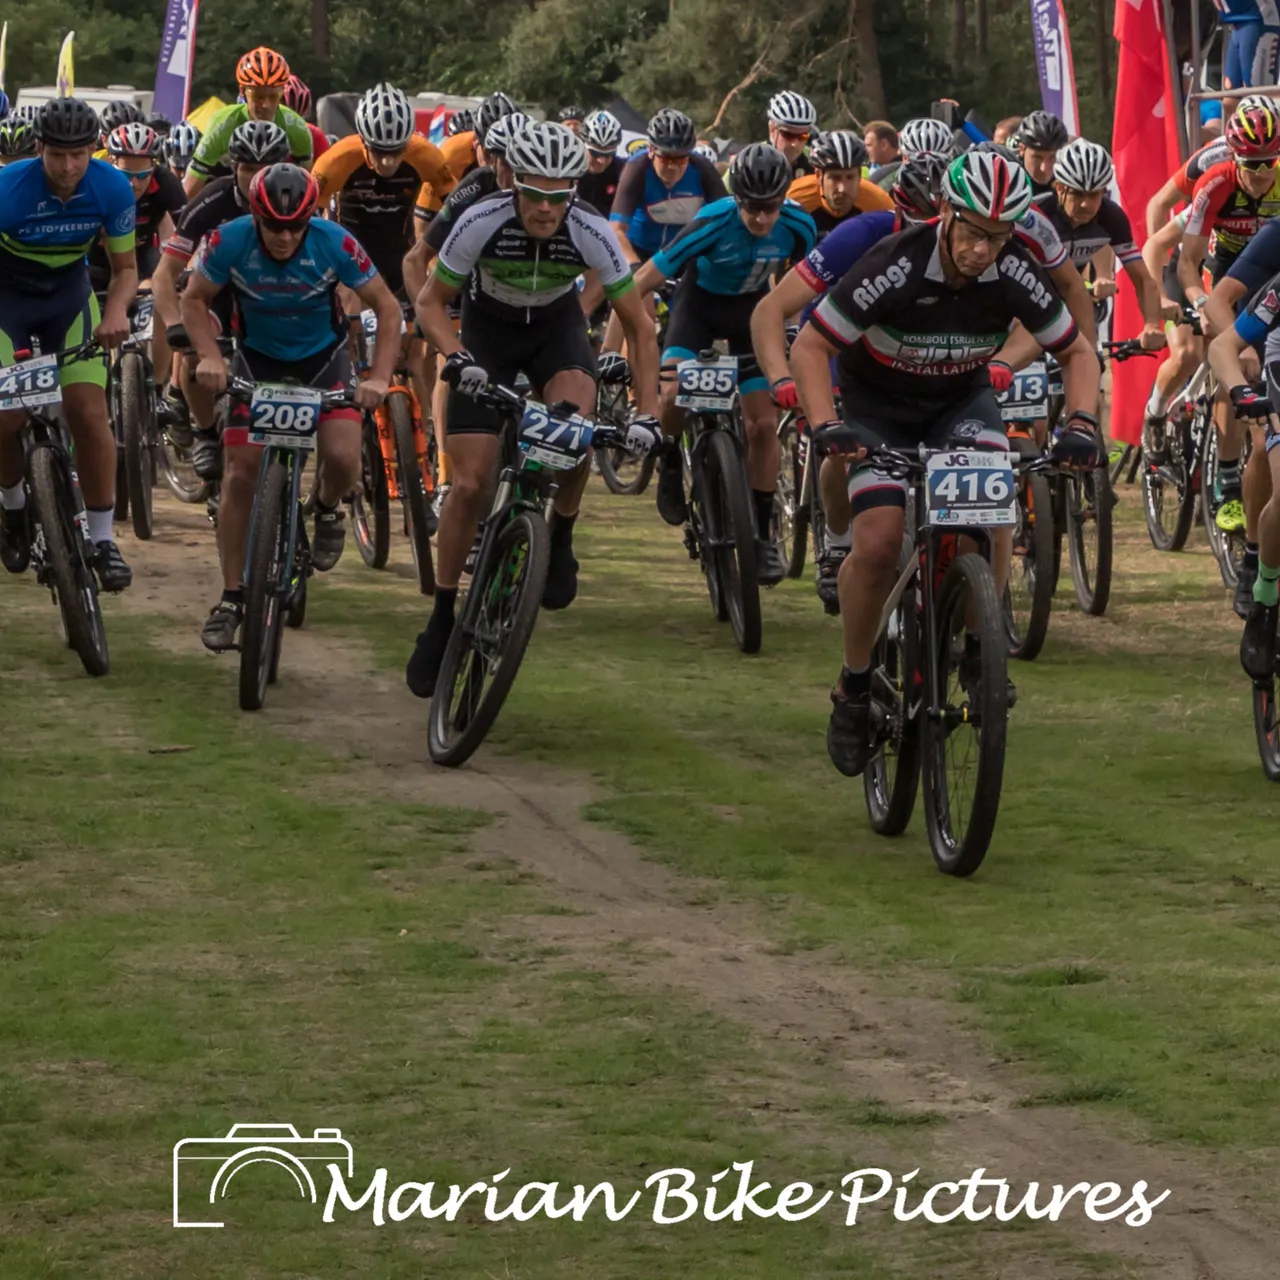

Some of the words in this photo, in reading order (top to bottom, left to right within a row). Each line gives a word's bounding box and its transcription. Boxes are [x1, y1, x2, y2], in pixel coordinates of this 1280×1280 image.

[450, 183, 481, 207] AGROS
[852, 256, 913, 311] Rings
[999, 254, 1053, 310] Rings
[0, 372, 55, 395] 418
[682, 368, 733, 393] 385
[253, 404, 316, 431] 208
[522, 412, 585, 450] 271
[944, 453, 969, 467] JG
[934, 471, 1009, 502] 416
